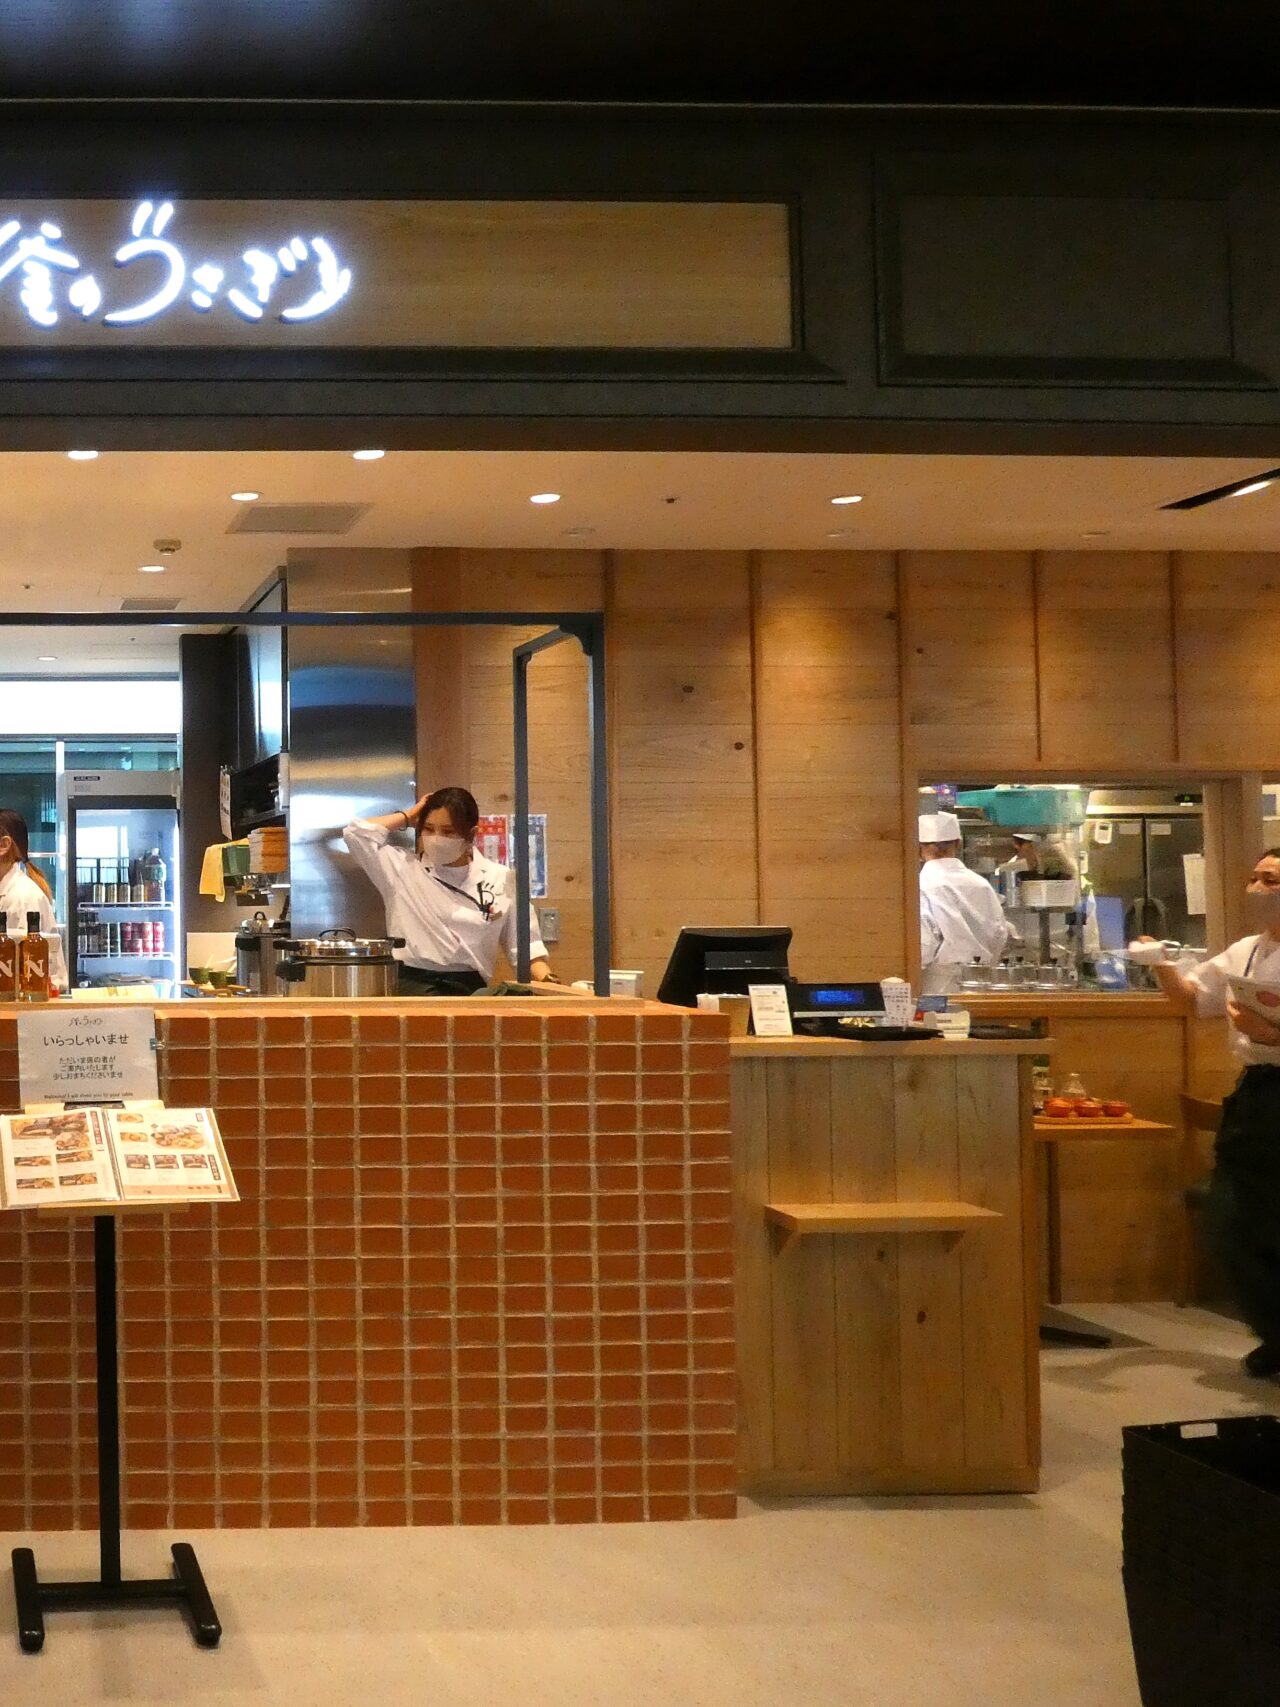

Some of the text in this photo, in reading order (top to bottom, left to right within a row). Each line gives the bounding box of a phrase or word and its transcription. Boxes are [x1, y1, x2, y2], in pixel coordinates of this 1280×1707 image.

[24, 959, 45, 978] N
[43, 1033, 130, 1047] いらっしゃいませ
